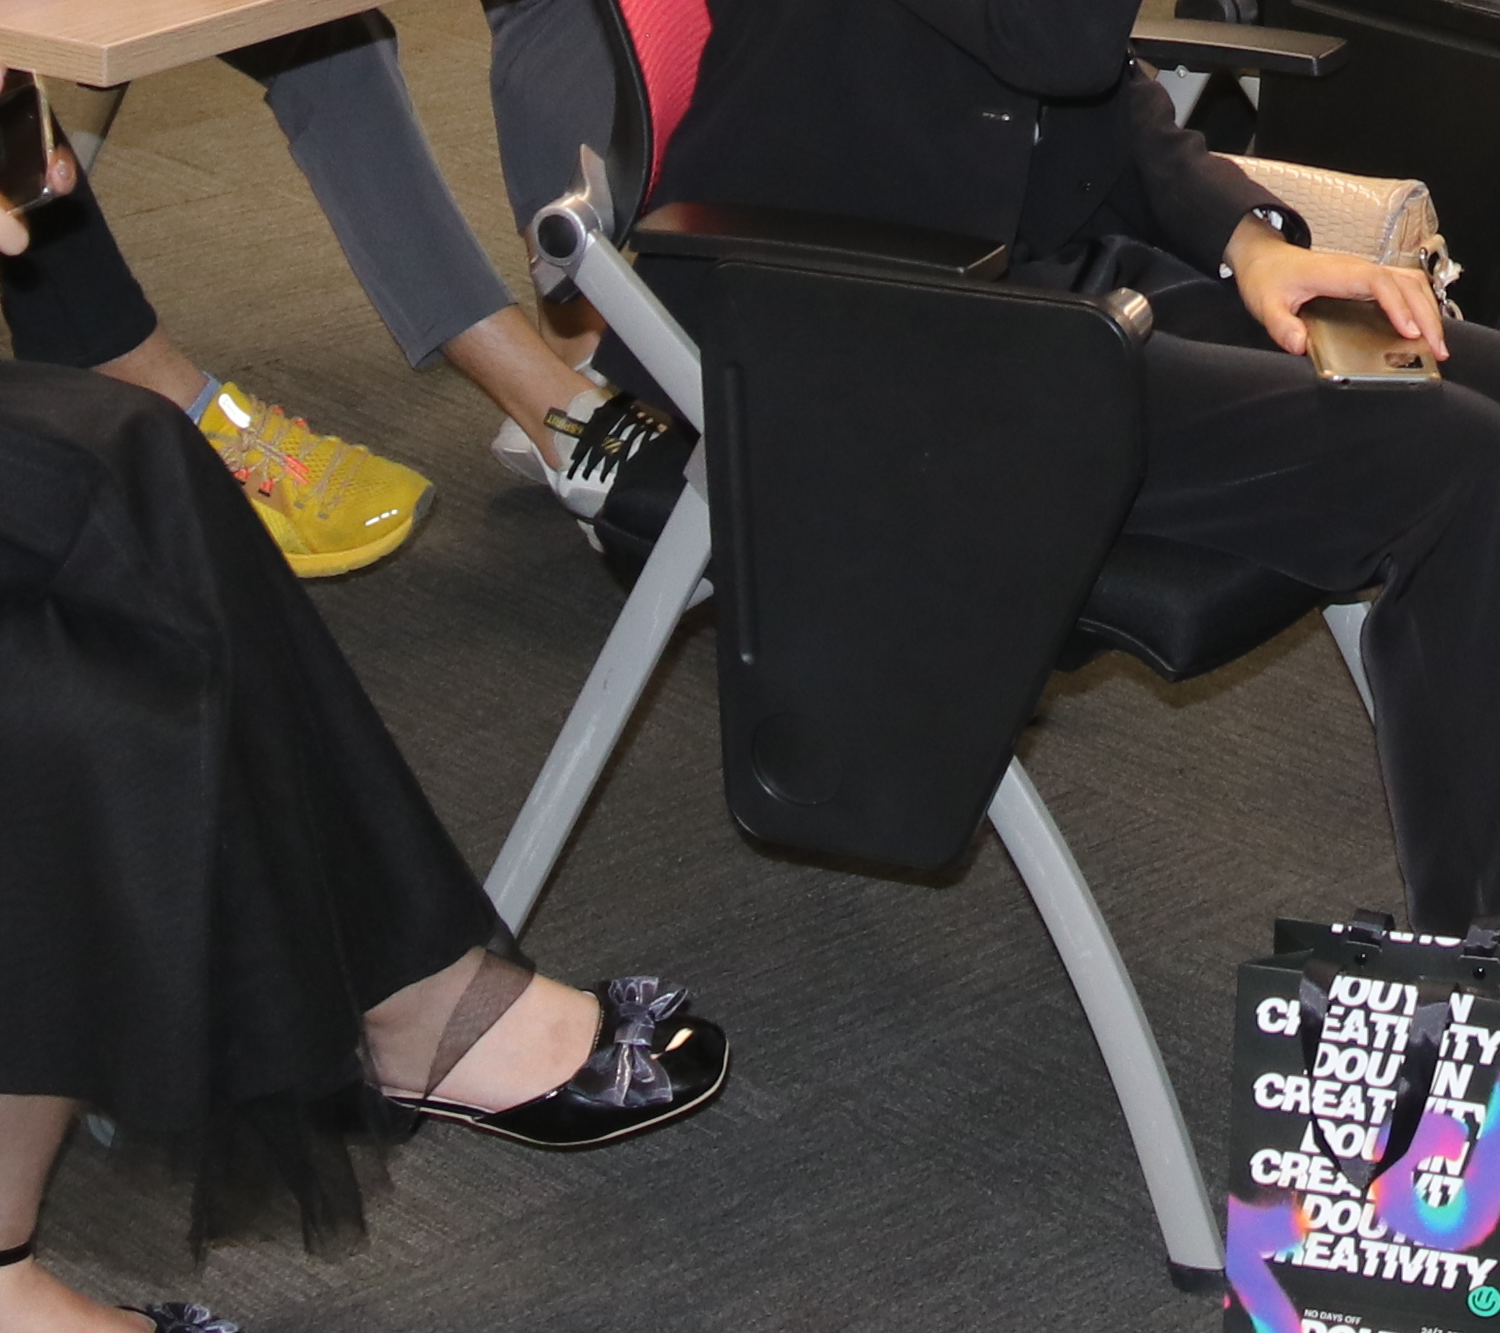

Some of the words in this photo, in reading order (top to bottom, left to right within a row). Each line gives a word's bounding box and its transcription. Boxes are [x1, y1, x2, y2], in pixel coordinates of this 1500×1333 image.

[1304, 1308, 1319, 1319] NO
[1319, 1310, 1349, 1323] DAYS
[1350, 1314, 1362, 1326] OFF
